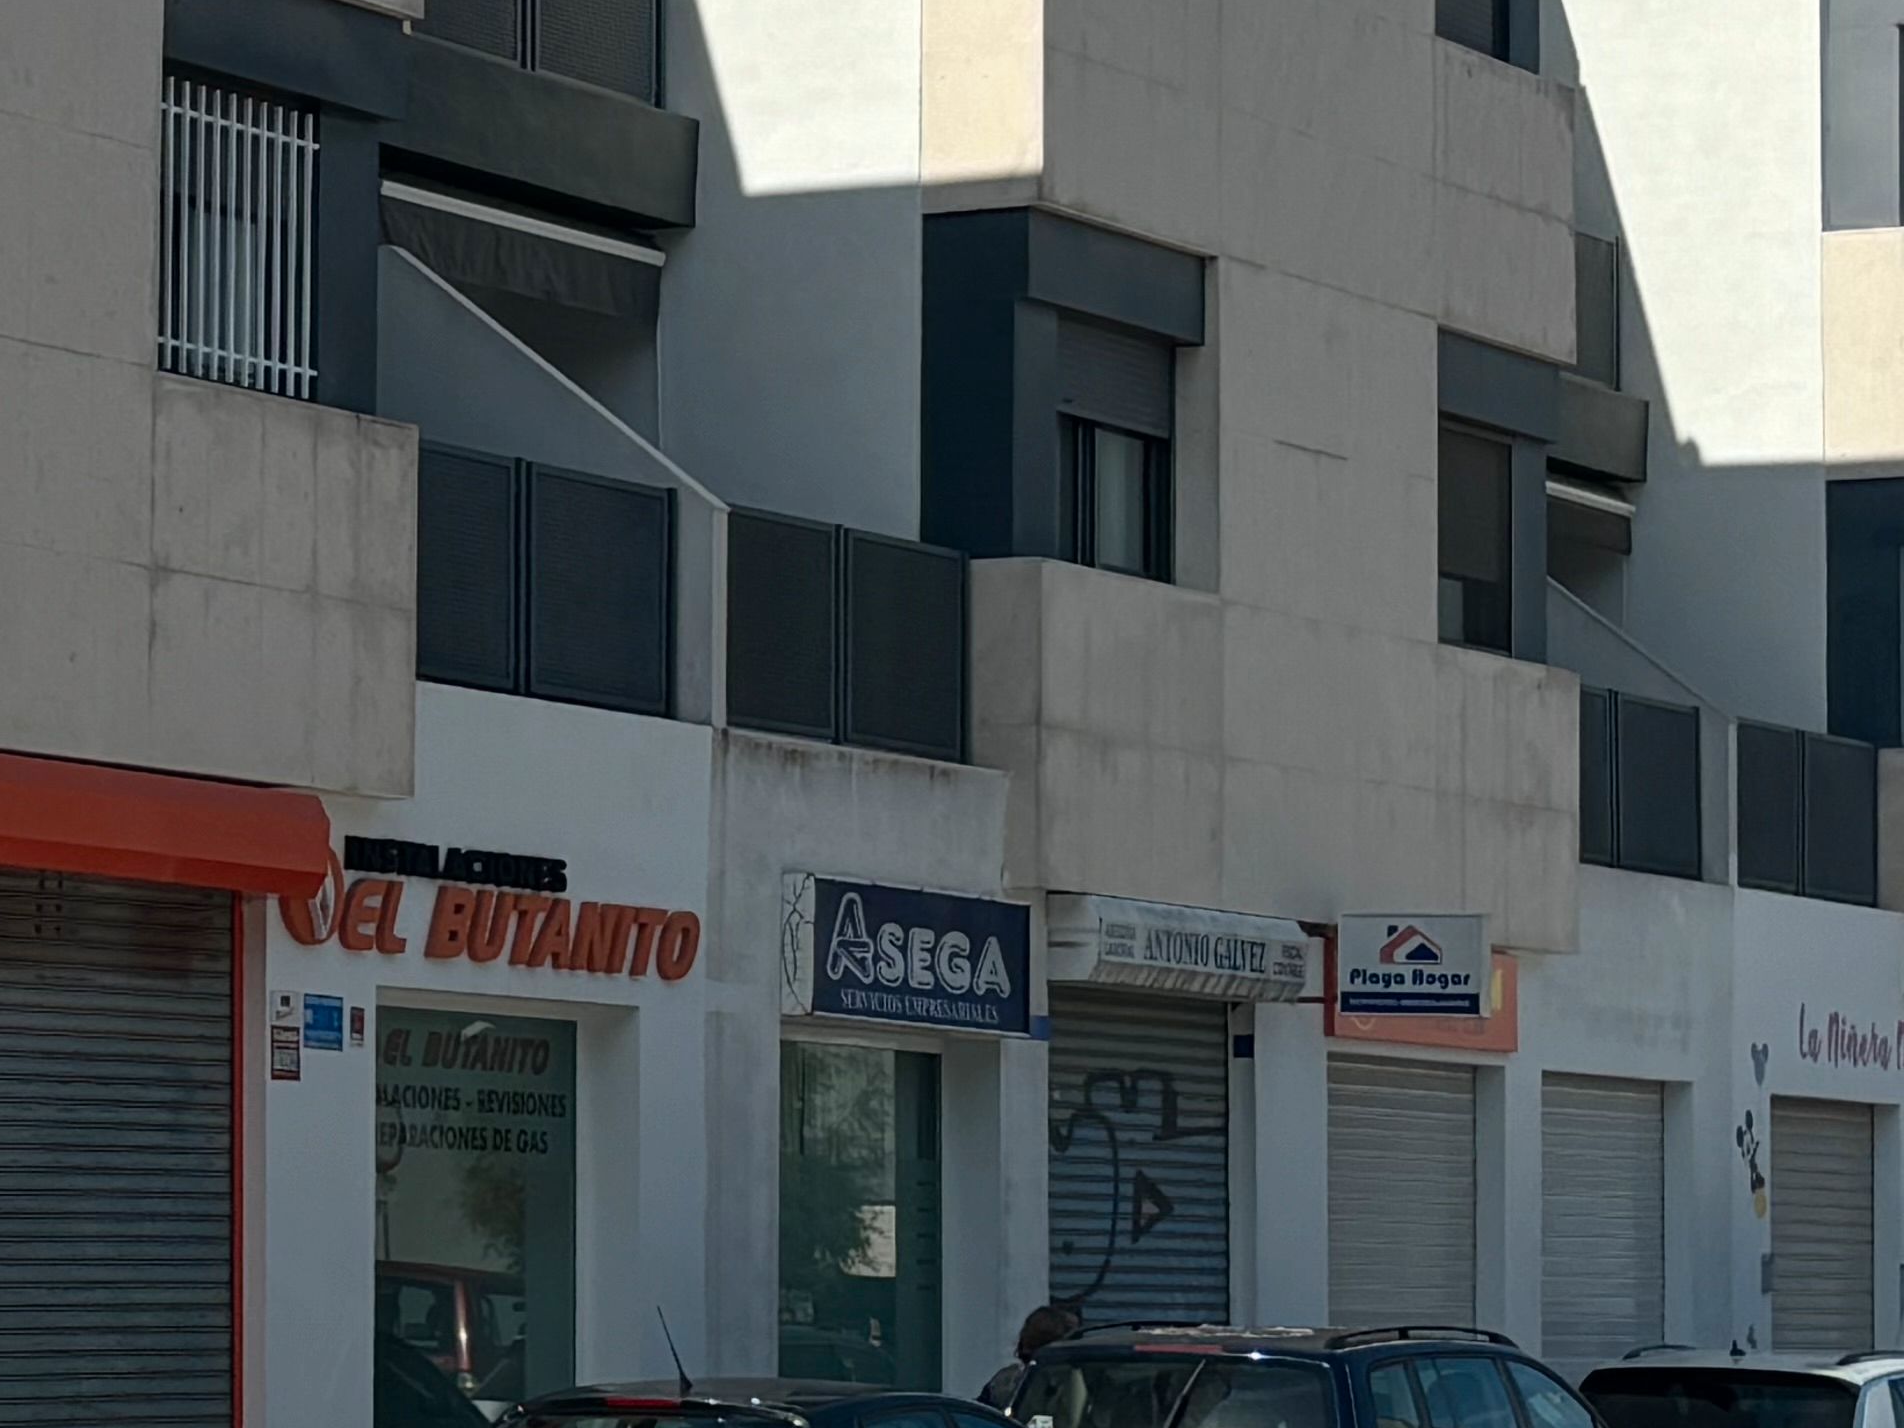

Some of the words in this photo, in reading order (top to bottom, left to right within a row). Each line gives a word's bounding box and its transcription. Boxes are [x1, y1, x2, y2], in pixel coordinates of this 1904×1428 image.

[338, 878, 406, 953] EL
[424, 884, 700, 981] BUTANITO
[826, 892, 1011, 998] ASEGA
[1144, 929, 1210, 967] ANTONIO
[1350, 968, 1405, 989] Playa
[1412, 969, 1470, 990] Hogar
[383, 1028, 412, 1066] EL
[421, 1030, 550, 1075] BUTANITO
[477, 1089, 567, 1118] REVISIONES
[377, 1122, 488, 1151] EPARACIONES
[492, 1128, 512, 1153] DE
[516, 1129, 548, 1154] GAS
